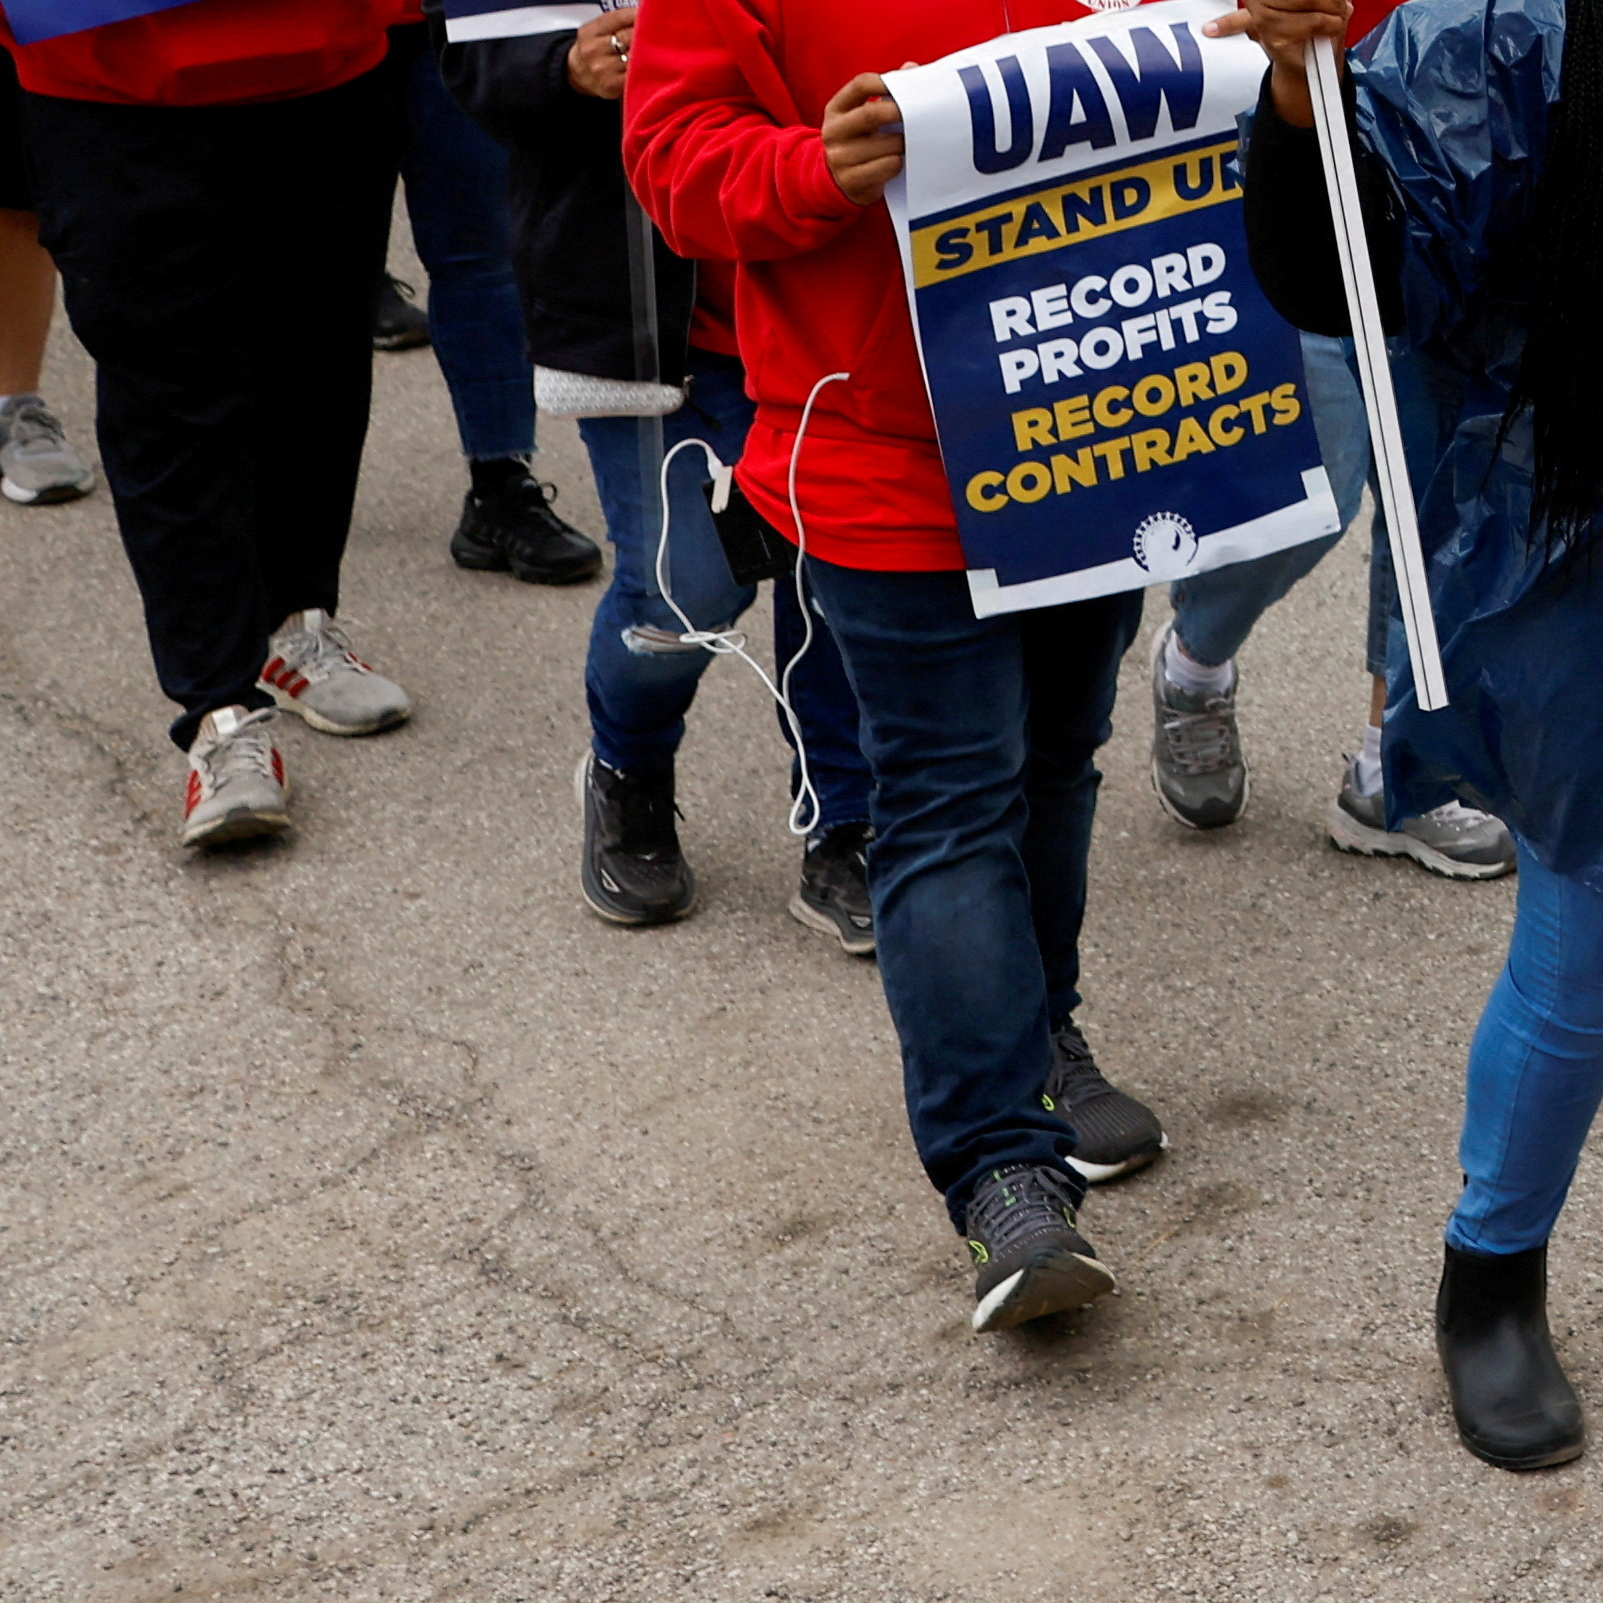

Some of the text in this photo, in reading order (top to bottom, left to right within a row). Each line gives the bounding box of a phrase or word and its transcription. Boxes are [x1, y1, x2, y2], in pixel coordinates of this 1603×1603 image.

[958, 21, 1204, 176] UAW
[935, 175, 1151, 271] STAND
[989, 242, 1226, 343] RECORD
[999, 291, 1238, 395] PROFITS
[965, 383, 1301, 513] CONTRACTS
[1012, 350, 1249, 453] RECORD
